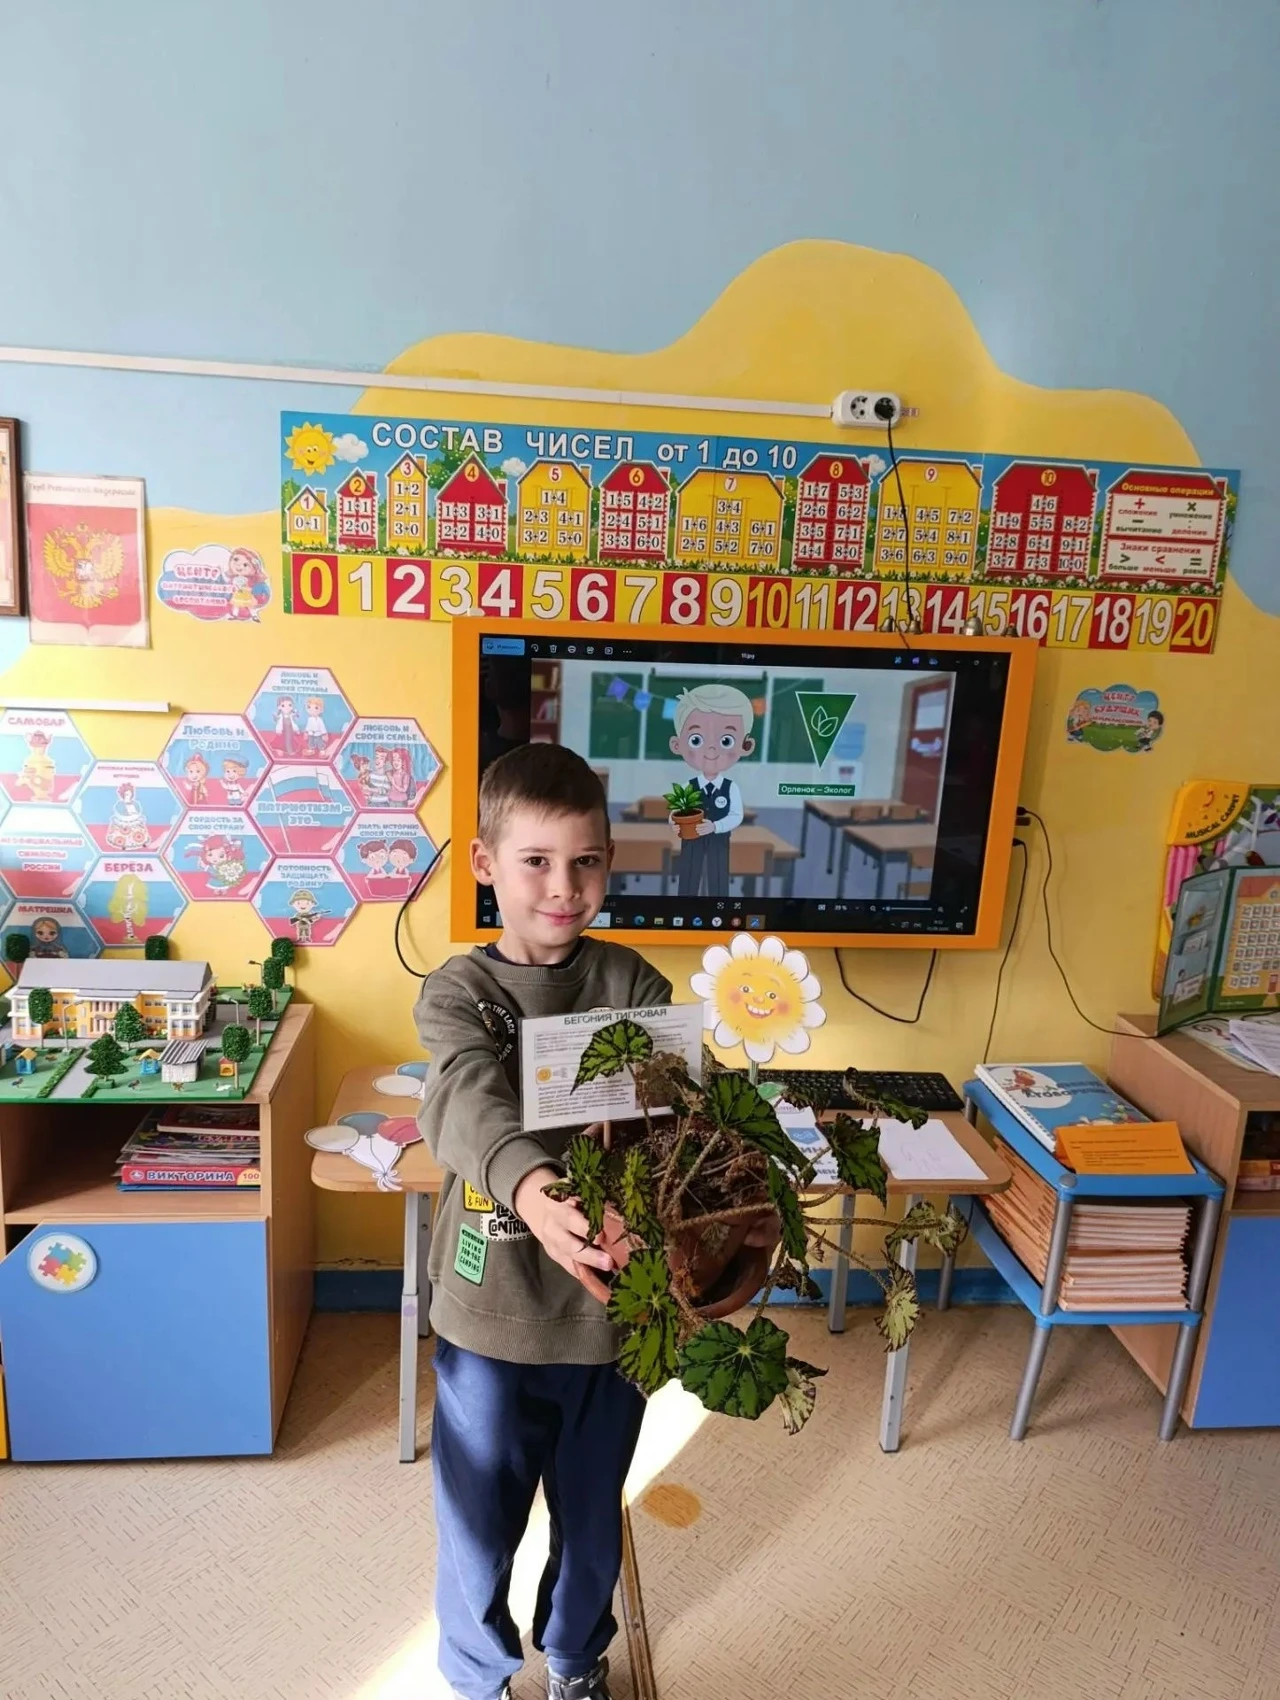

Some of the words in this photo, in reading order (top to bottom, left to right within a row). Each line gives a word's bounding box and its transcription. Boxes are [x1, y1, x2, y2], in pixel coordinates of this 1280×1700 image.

[372, 421, 502, 452] СОСТАВ
[526, 431, 633, 460] ЧИСЕЛ
[657, 443, 688, 462] от
[698, 440, 709, 463] 1
[722, 448, 758, 469] до
[768, 446, 797, 469] 10
[405, 462, 411, 475] 3
[467, 467, 476, 479] 4
[832, 463, 840, 476] 8
[551, 468, 559, 481] 5
[632, 471, 641, 483] 6
[927, 469, 935, 480] 9
[354, 479, 361, 492] 2
[728, 478, 734, 489] 7
[397, 484, 419, 495] 1+2
[808, 485, 827, 497] 1+7
[840, 487, 861, 498] 5+3
[1122, 483, 1168, 493] Основные
[1170, 487, 1214, 496] операции
[544, 492, 565, 503] 1+4
[610, 494, 631, 506] 1+5
[639, 497, 662, 508] 4+2
[304, 498, 309, 509] 1
[347, 501, 367, 512] 1+1
[718, 502, 740, 513] 3+4
[1033, 499, 1054, 509] 4+6
[396, 504, 417, 515] 2+1
[446, 506, 467, 517] 1+3
[478, 507, 499, 519] 3+1
[804, 504, 826, 515] 2+6
[838, 507, 860, 518] 6+2
[525, 511, 548, 522] 2+3
[560, 512, 580, 525] 4+1
[607, 515, 629, 526] 2+4
[917, 510, 939, 521] 4+5
[950, 511, 971, 522] 7+2
[1000, 515, 1019, 526] 1+9
[296, 518, 318, 529] 0+1
[346, 520, 369, 532] 2+0
[639, 517, 660, 529] 5+1
[684, 519, 707, 530] 1+6
[716, 521, 739, 532] 4+3
[1031, 519, 1052, 530] 5+5
[1065, 519, 1086, 530] 8+2
[395, 523, 419, 535] 3+0
[444, 526, 467, 537] 2+2
[477, 528, 499, 538] 4+0
[752, 523, 773, 536] 6+1
[802, 524, 824, 535] 3+5
[837, 528, 857, 538] 7+1
[883, 529, 905, 539] 2+7
[524, 531, 547, 542] 3+2
[559, 532, 581, 544] 5+0
[606, 535, 628, 546] 3+3
[915, 530, 937, 541] 5+4
[947, 532, 968, 543] 8+1
[638, 536, 660, 548] 6+0
[682, 539, 705, 550] 2+5
[715, 541, 737, 553] 5+2
[996, 536, 1016, 547] 2+8
[1029, 538, 1049, 549] 6+4
[1062, 540, 1082, 551] 9+1
[751, 543, 772, 554] 7+0
[800, 544, 821, 556] 4+4
[835, 546, 857, 557] 8+0
[1120, 543, 1148, 551] Знаки
[1151, 545, 1201, 554] сравнения
[881, 549, 903, 560] 3+6
[914, 550, 935, 561] 6+3
[945, 552, 967, 563] 9+0
[993, 556, 1014, 566] 3+7
[1027, 557, 1048, 568] 7+3
[1059, 558, 1082, 569] 10+0
[177, 567, 218, 578] ЦЕНТР
[300, 559, 333, 607] 0
[349, 561, 372, 612] 1
[392, 565, 425, 613] 2
[439, 566, 472, 617] 3
[481, 569, 515, 617] 4
[531, 571, 564, 619] 5
[577, 573, 608, 621] 6
[624, 576, 658, 624] 7
[670, 577, 700, 625] 8
[711, 579, 742, 626] 9
[749, 581, 788, 628] 10
[796, 583, 829, 630] 11
[837, 586, 877, 632] 12
[927, 588, 965, 635] 14
[970, 591, 1008, 636] 15
[1011, 594, 1047, 639] 16
[1052, 596, 1090, 642] 17
[1095, 598, 1132, 643] 18
[1136, 599, 1171, 645] 19
[1175, 603, 1213, 646] 20
[8, 717, 65, 726] САМОВАР
[182, 726, 232, 736] Любовь
[191, 739, 239, 749] Родине
[258, 803, 340, 812] ПАТРИОТИЗМ
[1185, 821, 1220, 838] MUSICAL
[1221, 794, 1239, 822] CARPET
[493, 1005, 506, 1016] THE
[504, 1015, 515, 1034] LACK
[564, 1013, 612, 1025] БЕГОНИЯ
[615, 1008, 667, 1019] ТИГРОВАЯ
[147, 1171, 235, 1181] ВИКТОРИНА
[475, 1196, 488, 1207] FUN
[462, 1240, 481, 1254] LIVING
[459, 1256, 480, 1272] CAMPING
